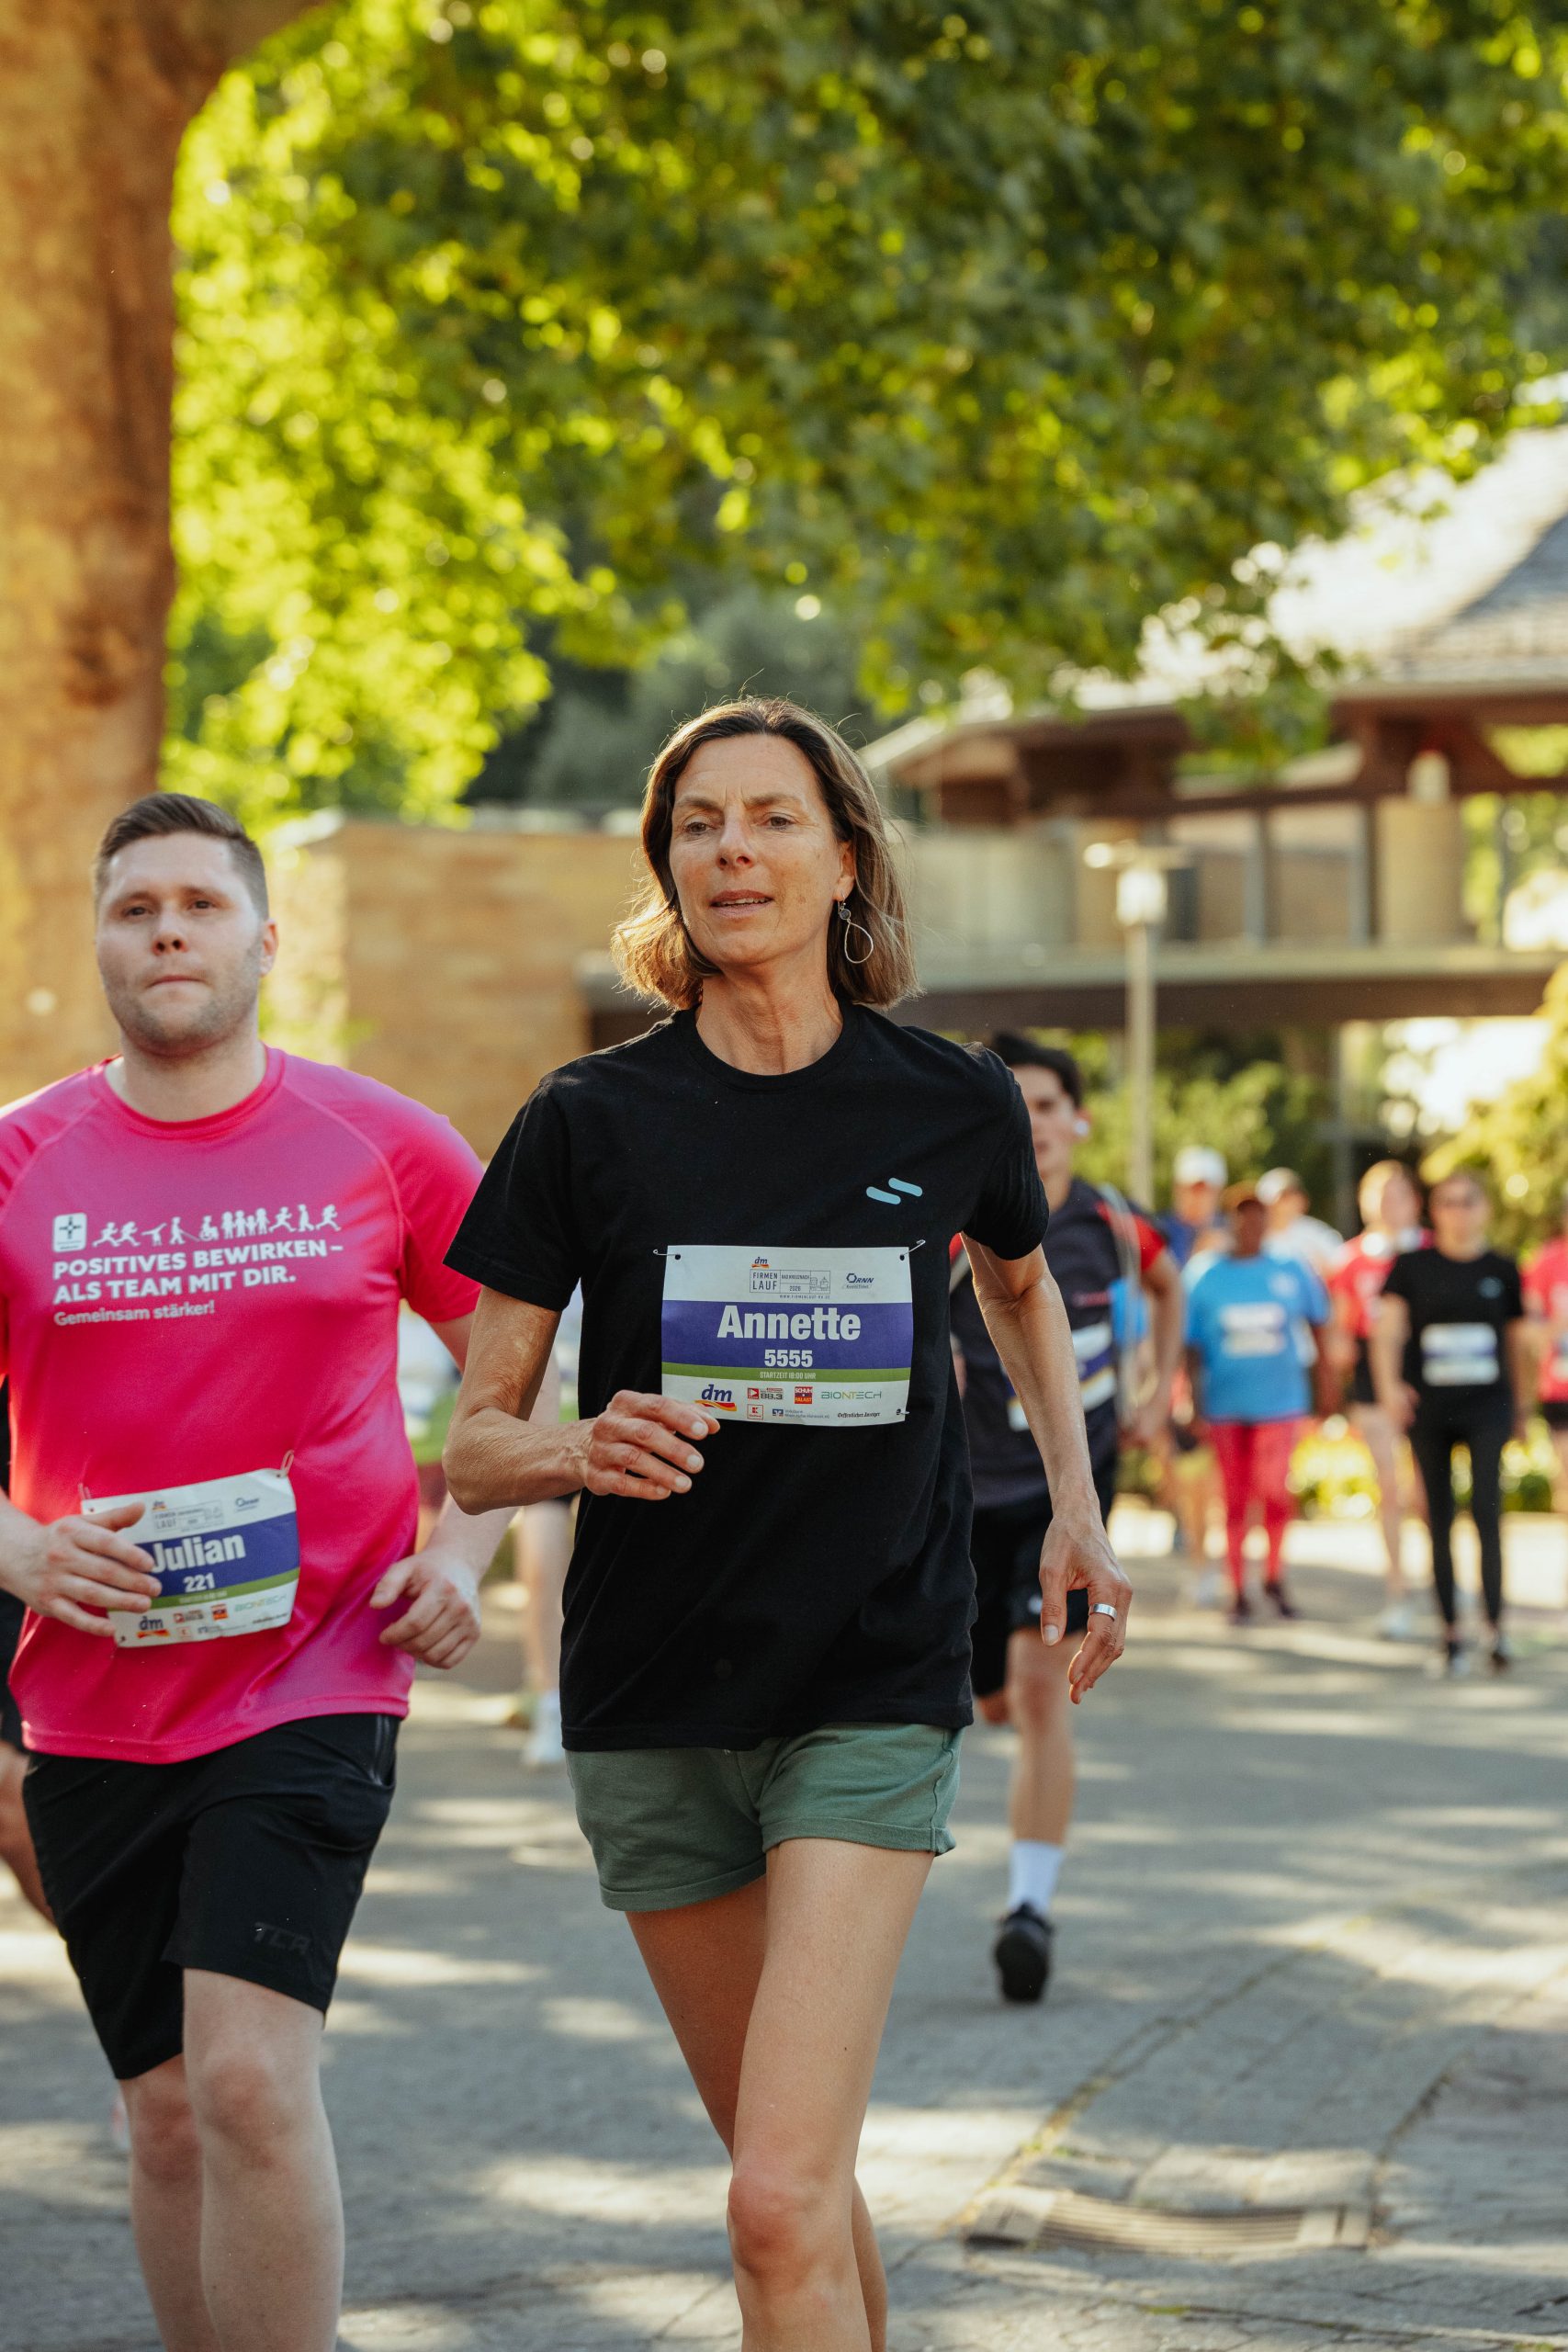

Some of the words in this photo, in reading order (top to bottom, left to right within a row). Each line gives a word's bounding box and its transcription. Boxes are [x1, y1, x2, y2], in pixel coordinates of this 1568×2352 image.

[53, 1252, 187, 1280] POSITIVES
[754, 1256, 768, 1265] dm
[53, 1281, 102, 1305] ALS
[106, 1277, 183, 1299] TEAM
[188, 1271, 236, 1294] MIT
[243, 1265, 297, 1287] DIR.
[752, 1272, 778, 1280] FIRMEN
[752, 1280, 778, 1291] LAUF
[54, 1305, 150, 1326] Gemeinsam
[153, 1300, 215, 1319] stärker!
[717, 1305, 861, 1340] Annette
[764, 1349, 813, 1367] 5555
[760, 1371, 788, 1379] STARTZEIT
[701, 1384, 732, 1403] dm
[152, 1534, 246, 1574] Julian
[183, 1572, 216, 1592] 221
[139, 1615, 164, 1630] dm
